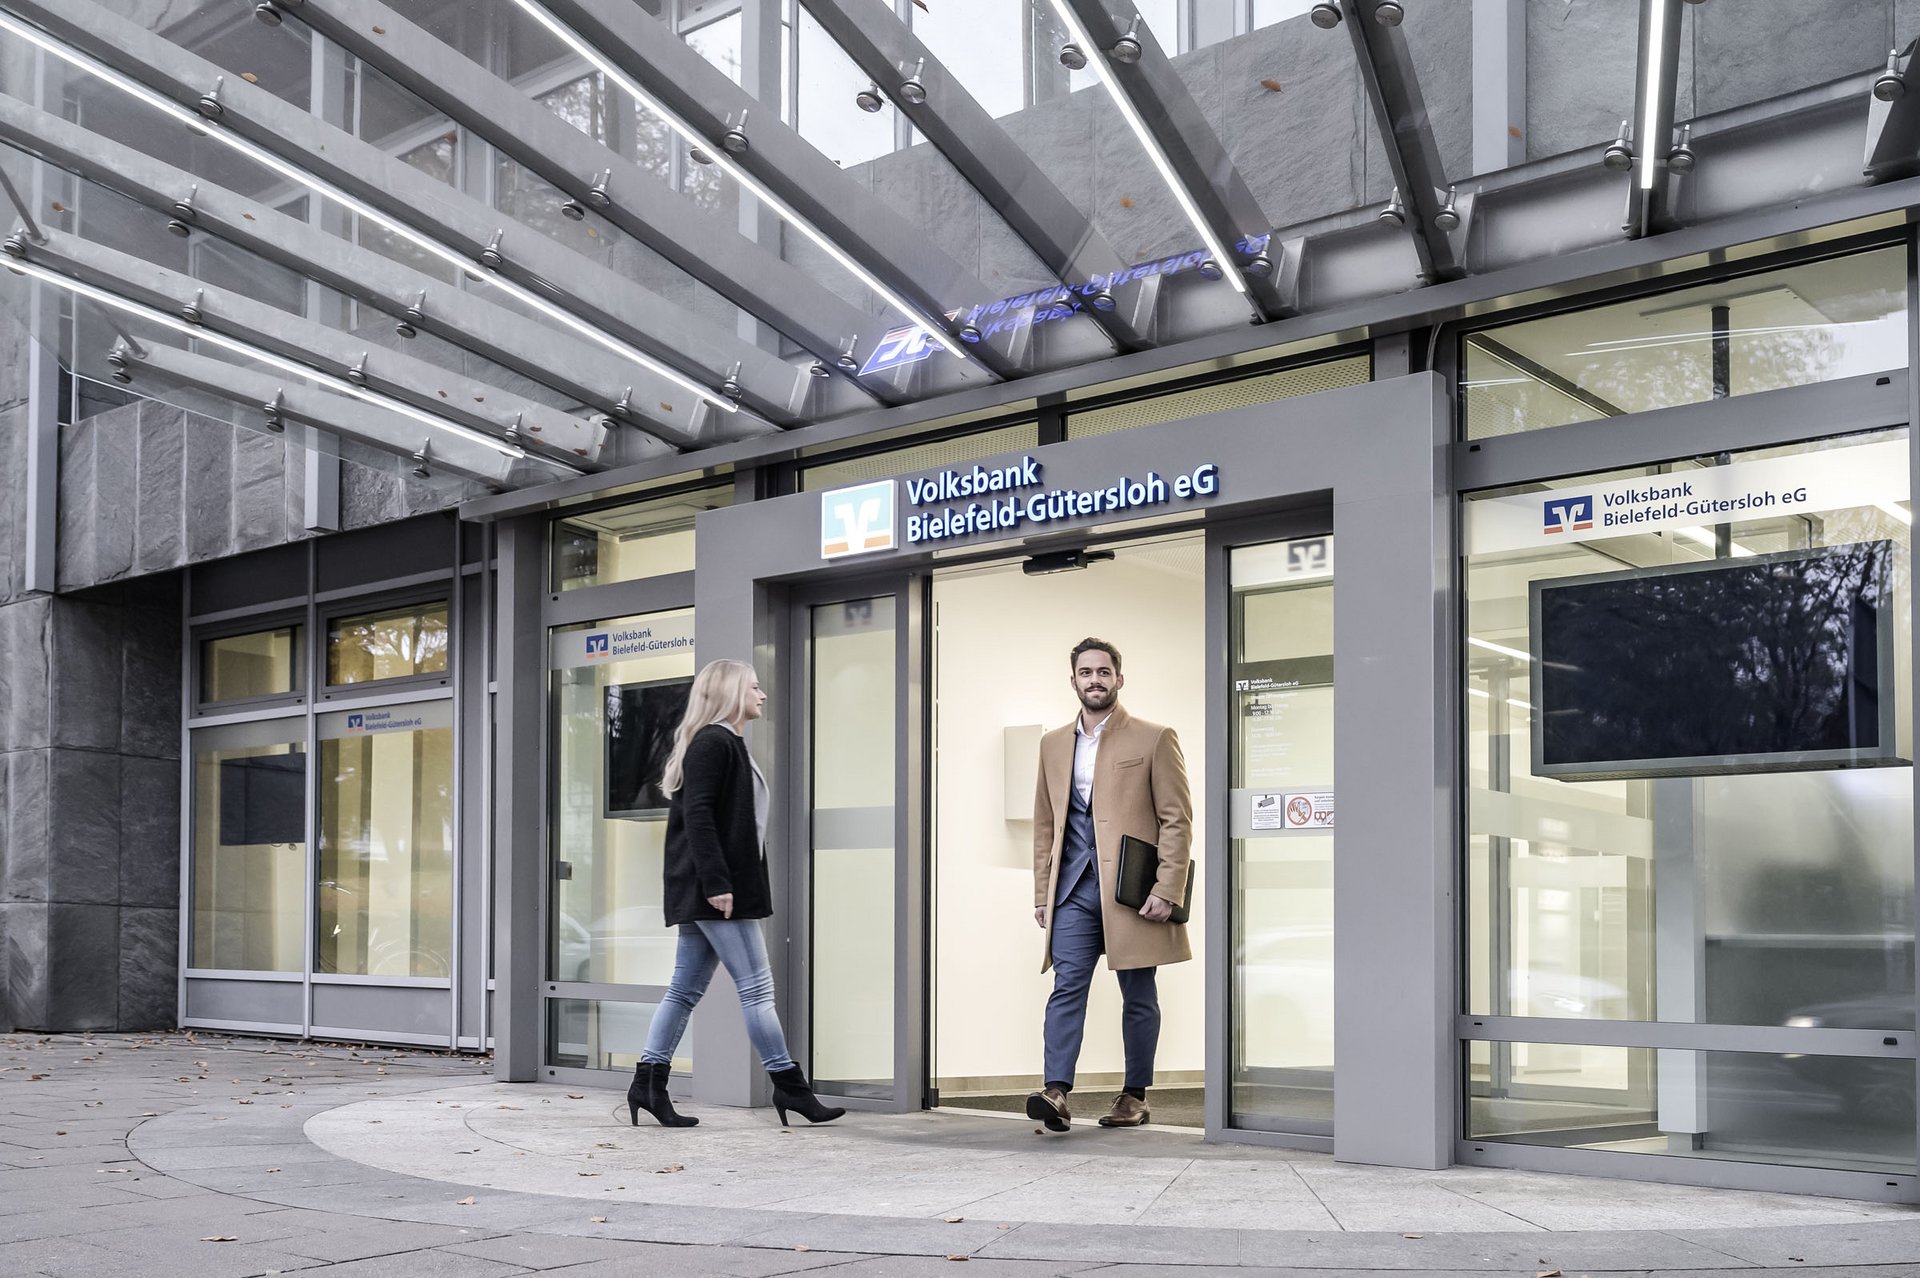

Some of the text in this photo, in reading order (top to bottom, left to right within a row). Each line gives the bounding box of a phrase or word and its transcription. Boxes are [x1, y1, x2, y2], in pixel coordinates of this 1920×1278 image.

[906, 456, 1041, 506] Volksbank
[906, 463, 1218, 543] Bielefeld-Gütersloh eG
[1603, 482, 1693, 507] Volksbank
[1603, 487, 1807, 527] Bielefeld-Gütersloh eG
[612, 628, 652, 642] Volksbank
[612, 637, 687, 655] Bielefeld-Gütersloh
[1250, 677, 1273, 685] Volksbank
[365, 712, 390, 720] Volksbank
